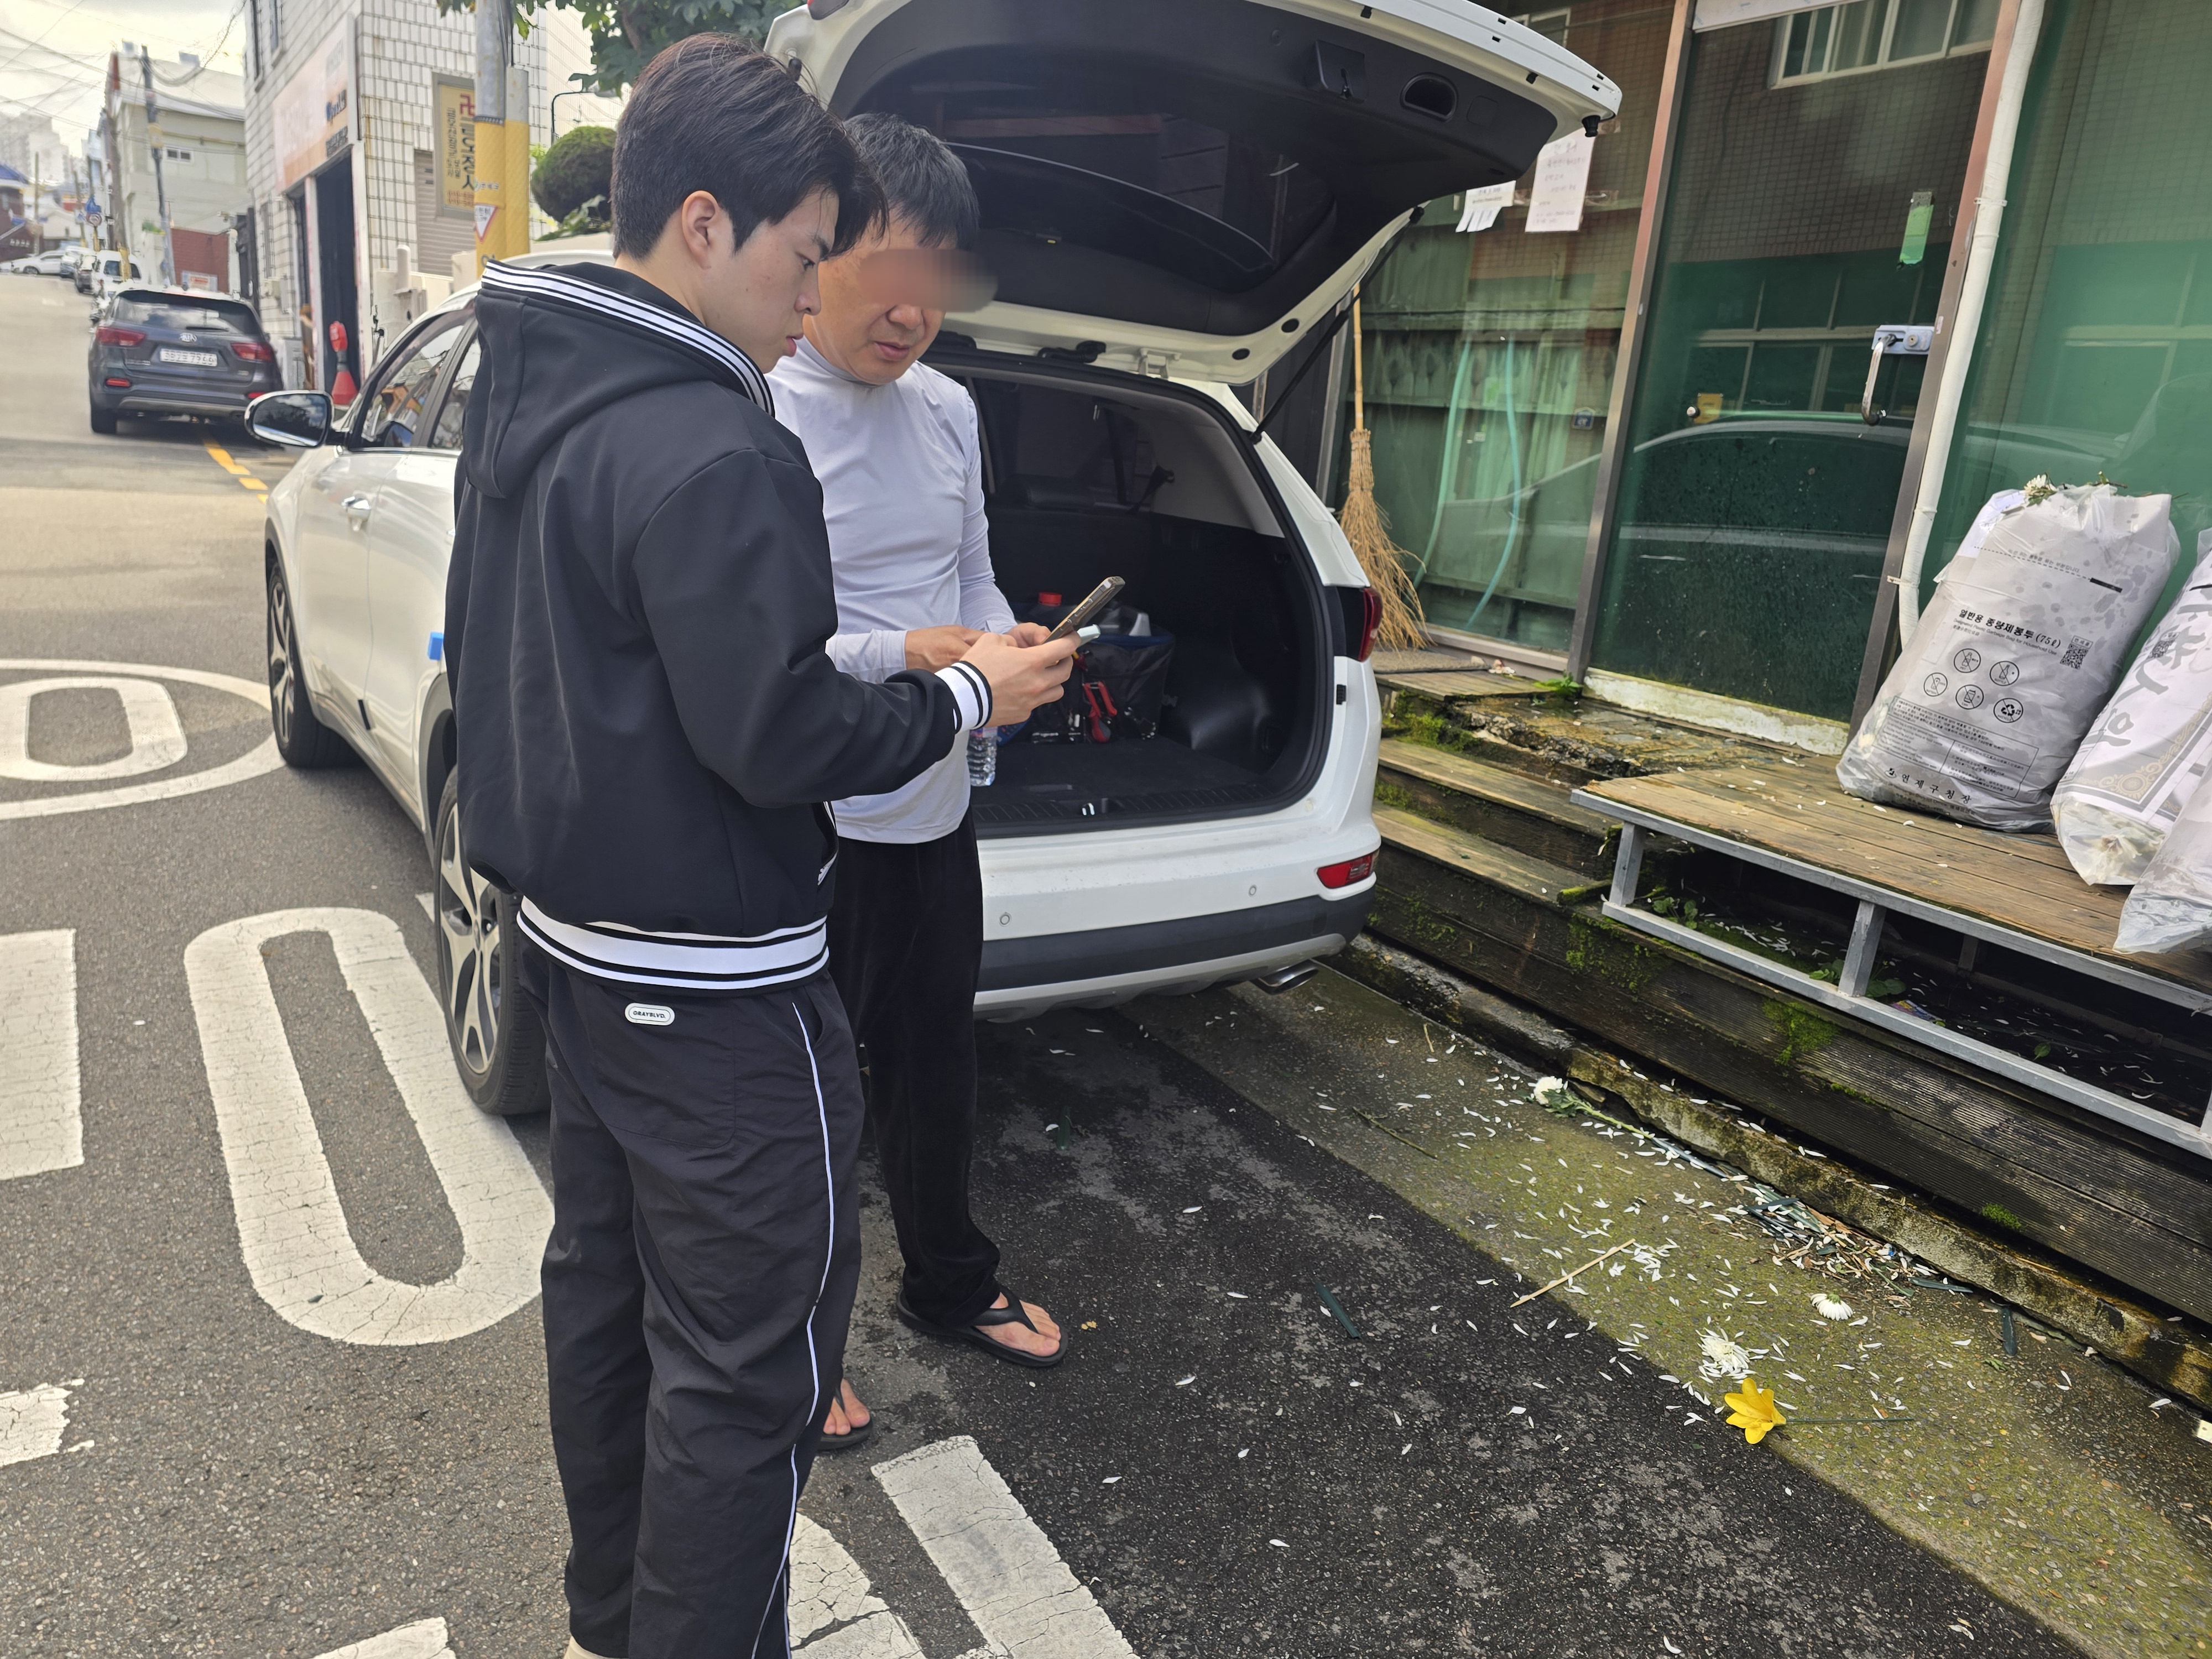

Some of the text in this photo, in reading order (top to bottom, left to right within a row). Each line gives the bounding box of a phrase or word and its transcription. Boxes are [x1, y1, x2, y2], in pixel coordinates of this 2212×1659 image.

[1959, 609, 1984, 623] 일반용
[1986, 617, 2034, 639] 종량제봉투
[1986, 628, 2006, 638] Garbage
[2023, 639, 2048, 653] Household
[1902, 774, 1971, 804] 연제구청장
